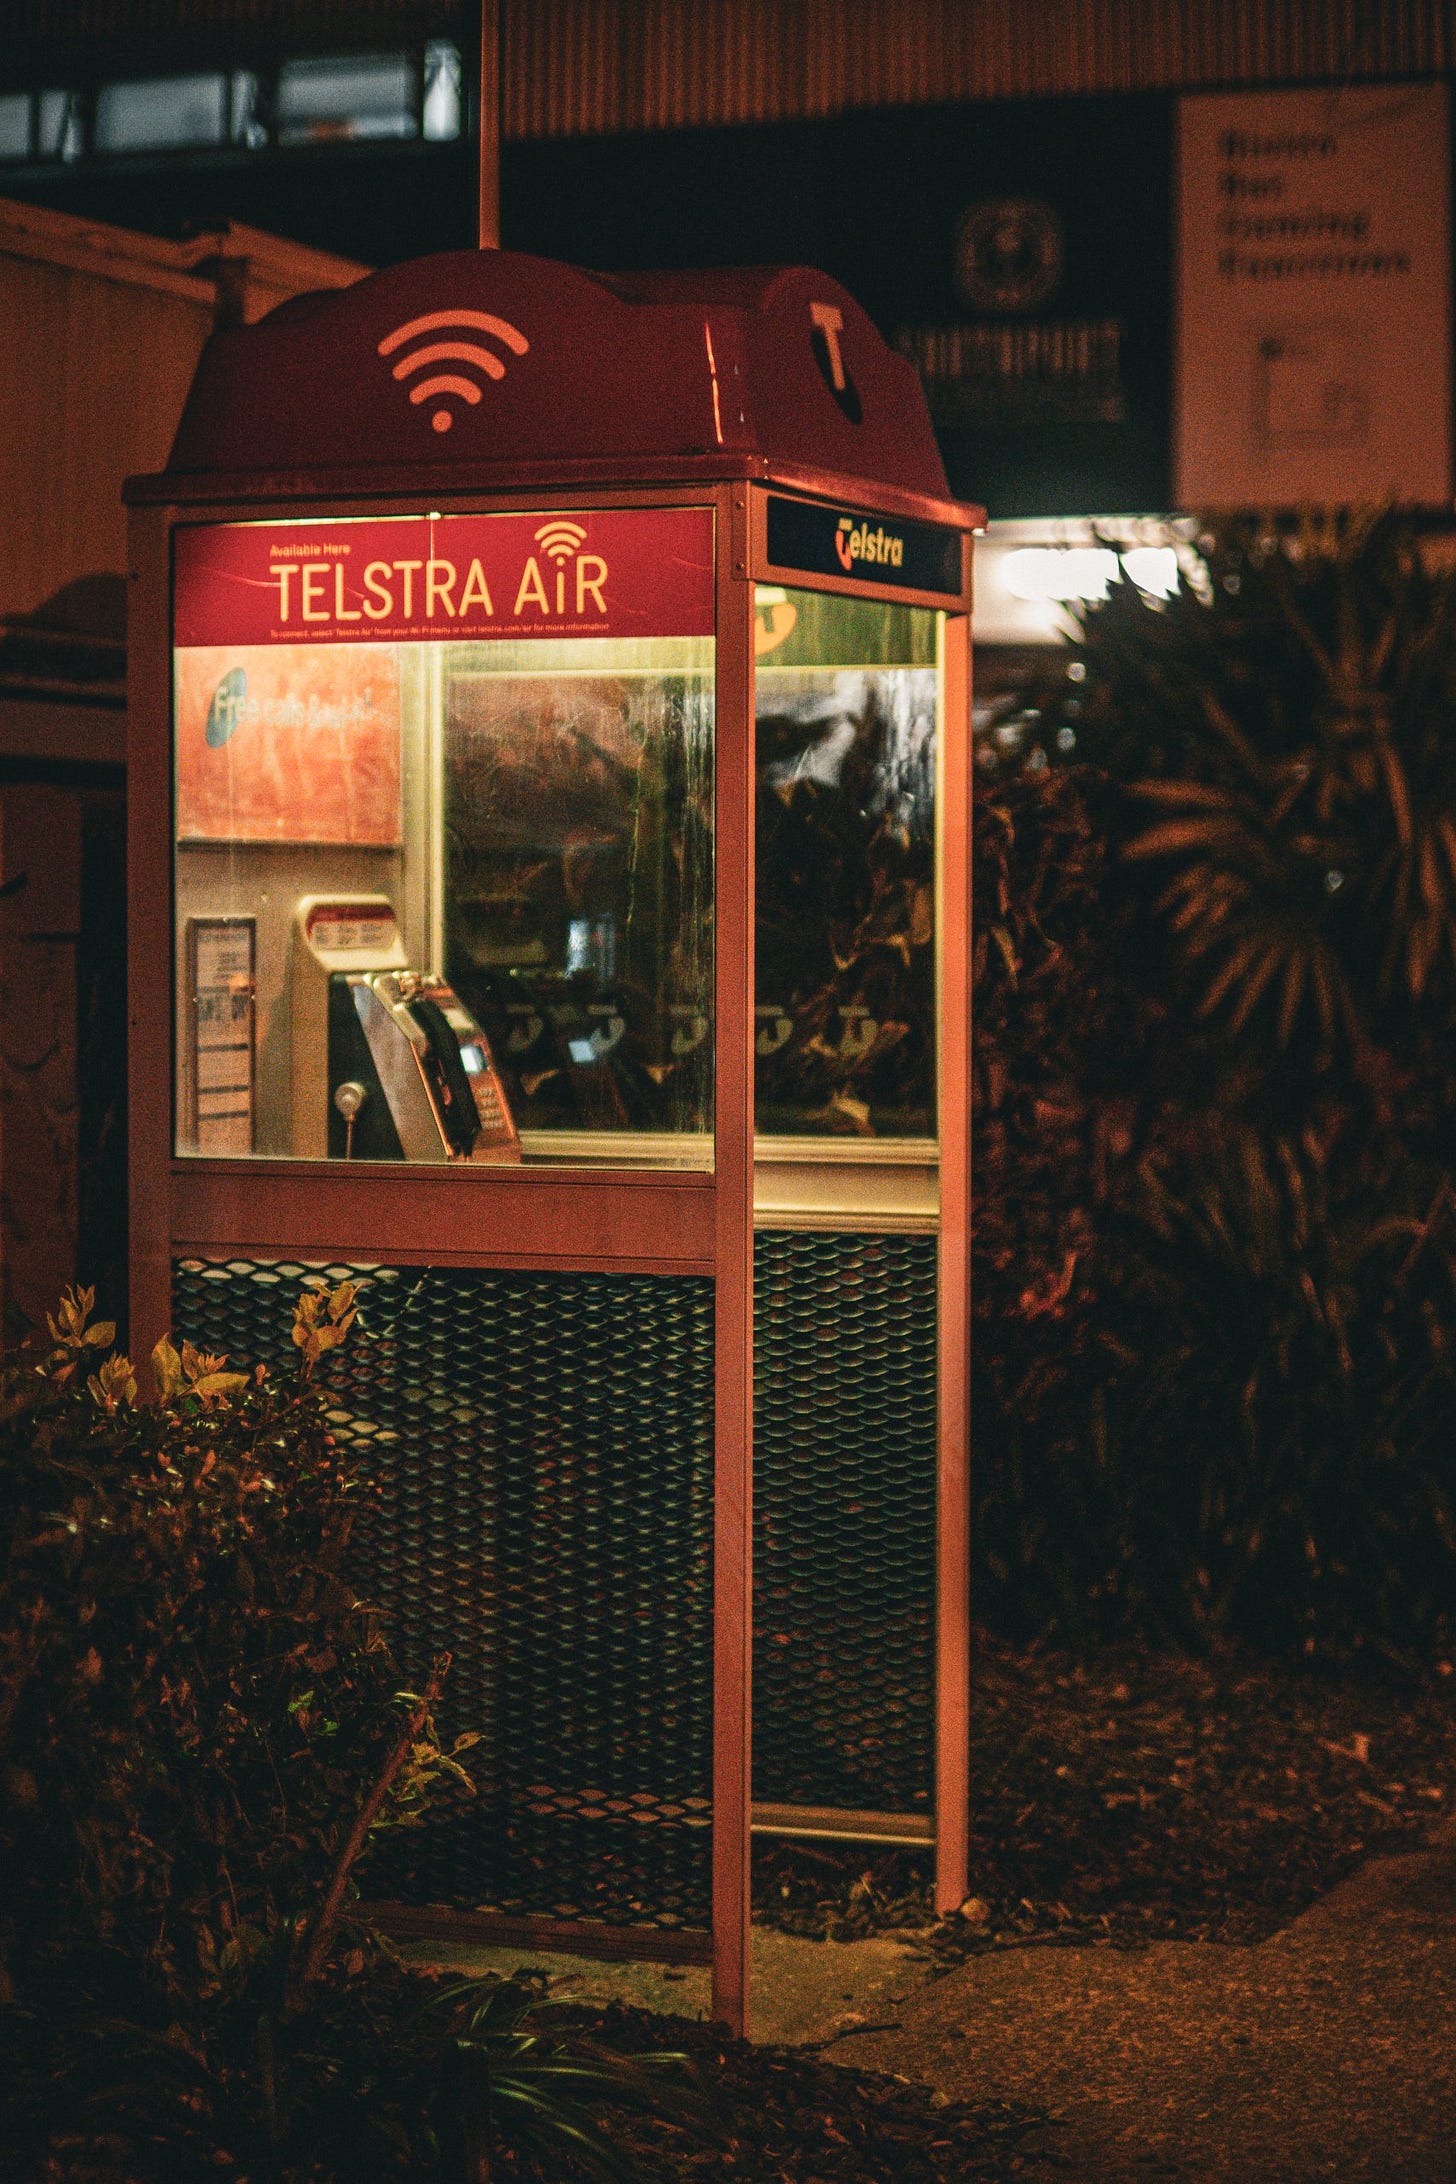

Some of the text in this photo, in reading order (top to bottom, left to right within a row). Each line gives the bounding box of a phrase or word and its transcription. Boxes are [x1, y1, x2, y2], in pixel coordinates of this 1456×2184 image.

[269, 543, 351, 558] Available Here
[835, 518, 904, 571] Telstra
[269, 558, 493, 622] TELSTRA
